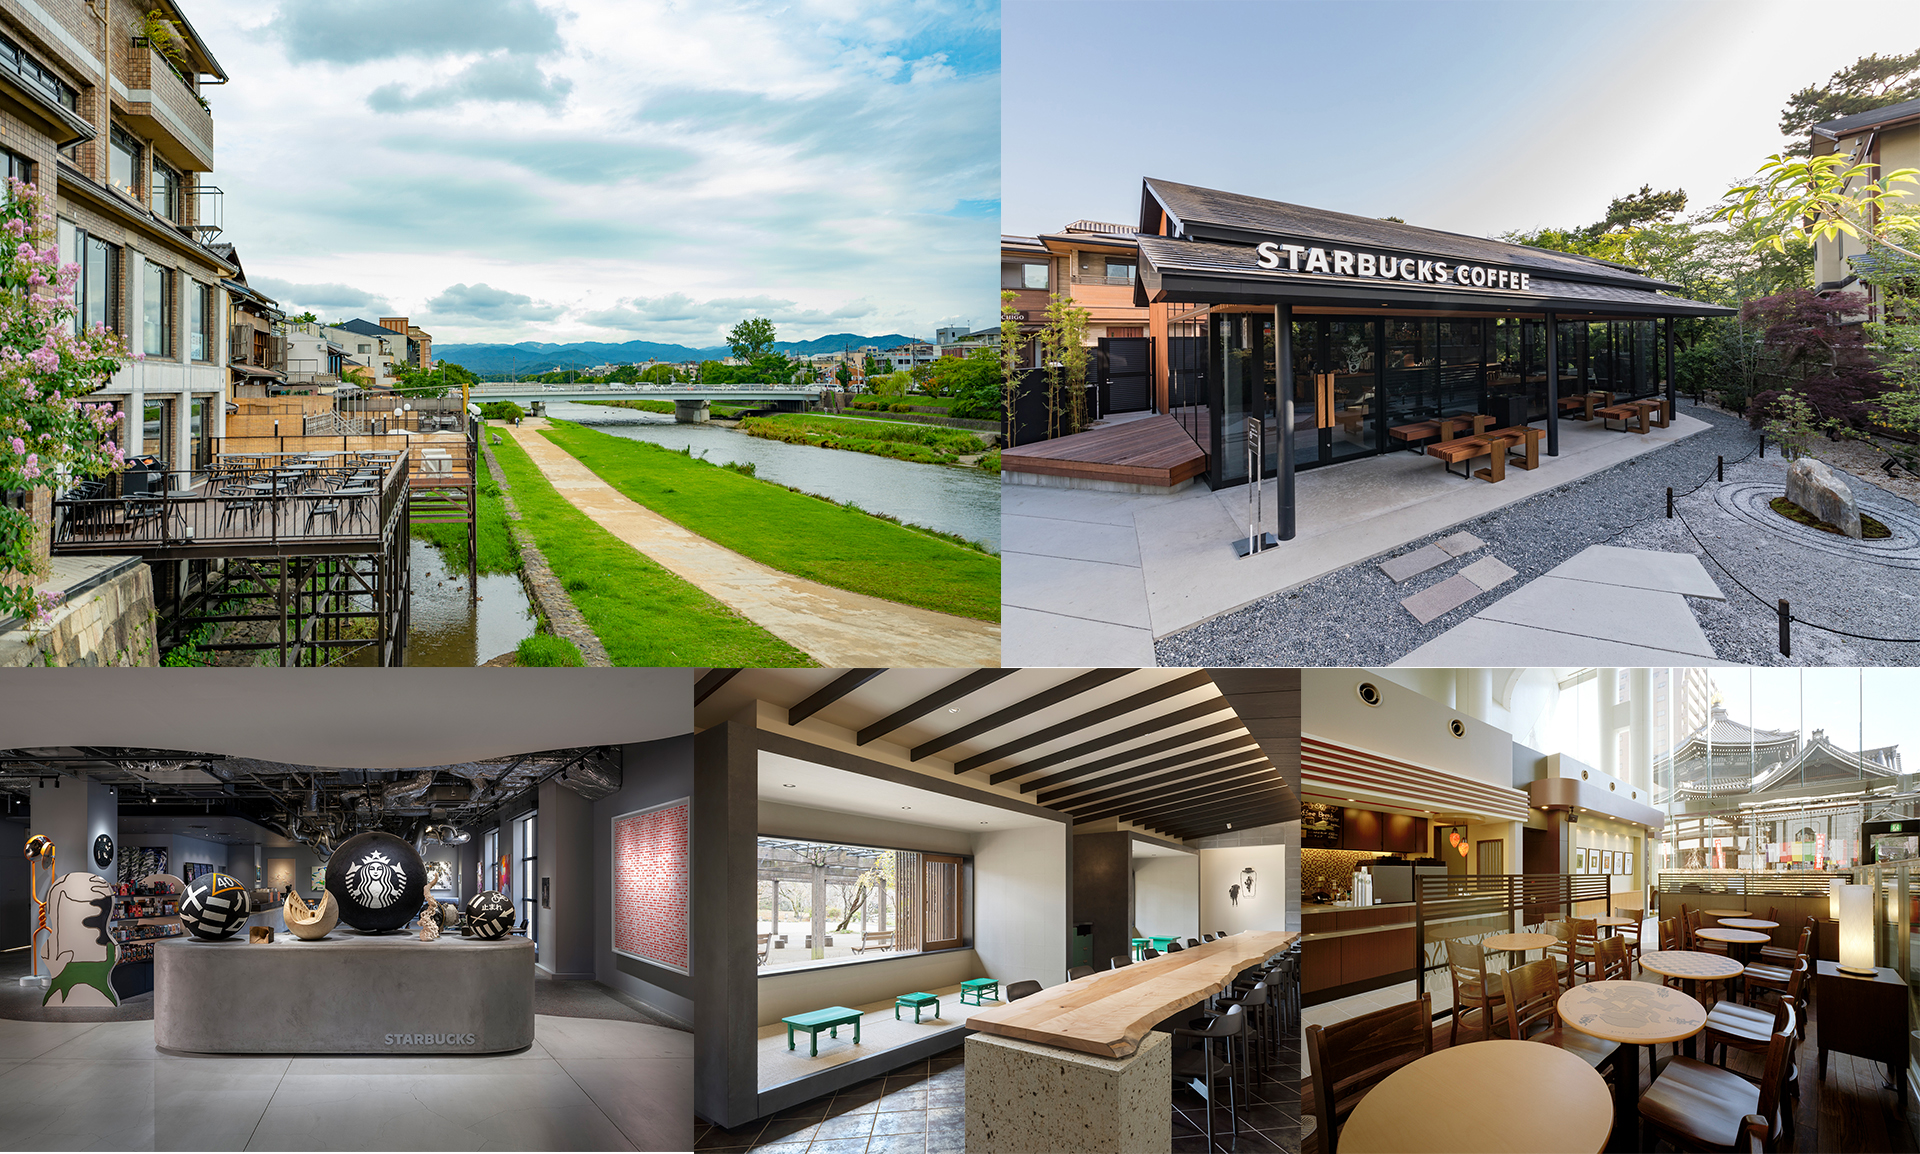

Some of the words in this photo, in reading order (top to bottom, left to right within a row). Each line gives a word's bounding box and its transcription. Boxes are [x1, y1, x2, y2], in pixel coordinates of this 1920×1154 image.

[1256, 241, 1448, 282] STARBUCKS
[1454, 264, 1530, 291] COFFEE
[217, 876, 235, 888] 40
[481, 903, 503, 911] 止まれ
[384, 1033, 476, 1045] STARBUCKS
